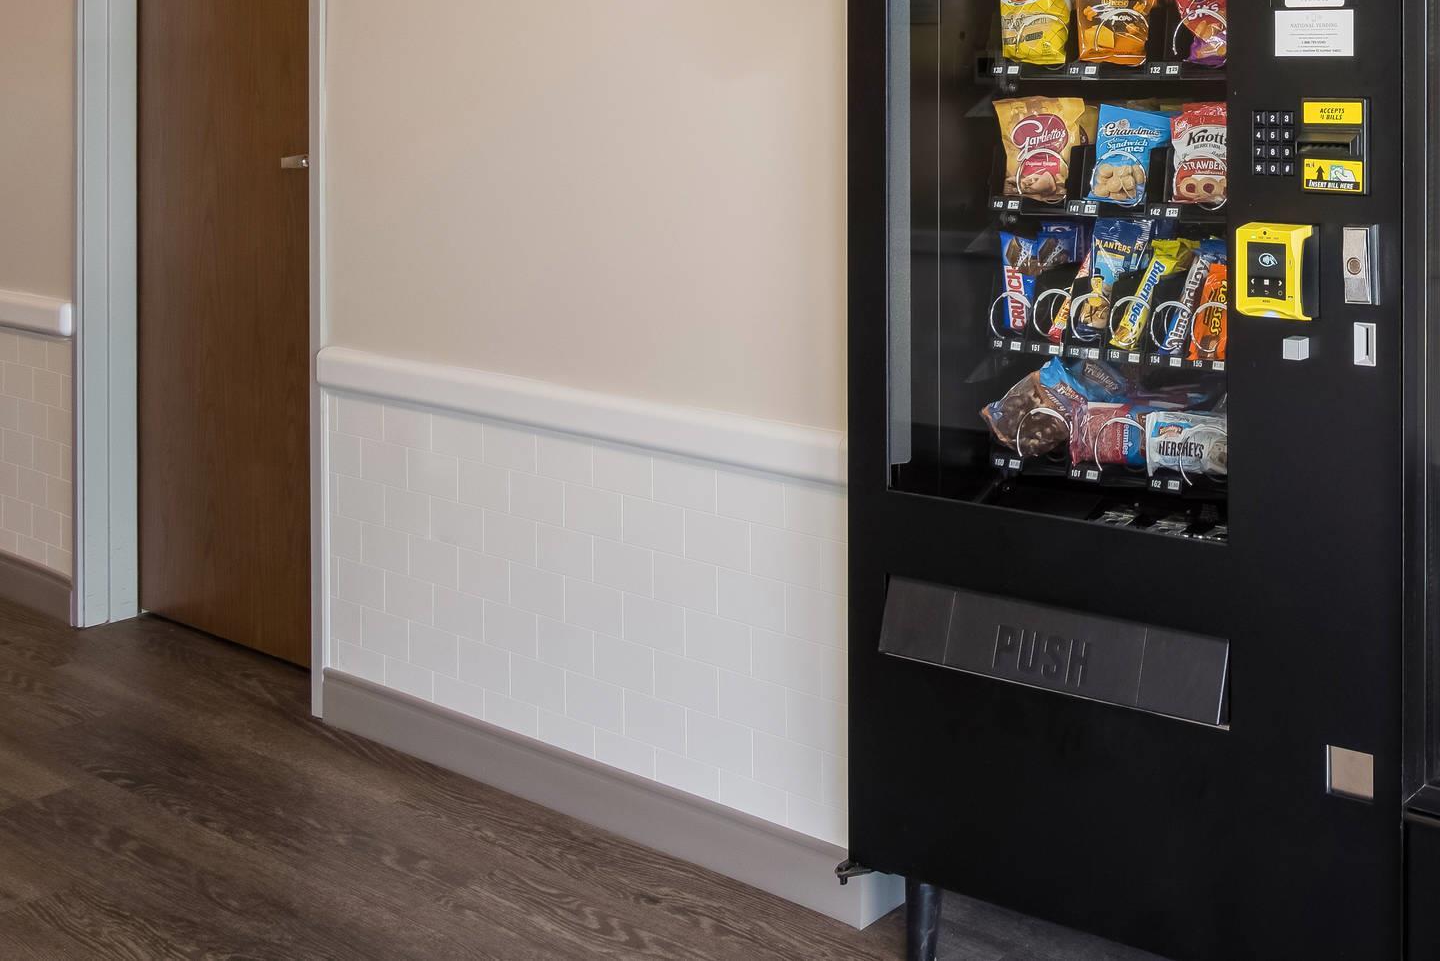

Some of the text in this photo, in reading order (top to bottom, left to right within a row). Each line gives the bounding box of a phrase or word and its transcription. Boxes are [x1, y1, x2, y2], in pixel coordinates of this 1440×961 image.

[1150, 66, 1161, 74] 132
[1106, 139, 1150, 149] Sandwich
[1270, 148, 1275, 156] 8
[1284, 148, 1290, 156] 9
[1308, 179, 1354, 190] INSERT BILL HERE
[1095, 238, 1132, 254] PLANTERS
[1031, 344, 1040, 352] 151
[1070, 347, 1079, 355] 152
[1110, 351, 1120, 359] 153
[1151, 480, 1161, 488] 162
[993, 624, 1092, 688] PUSH
